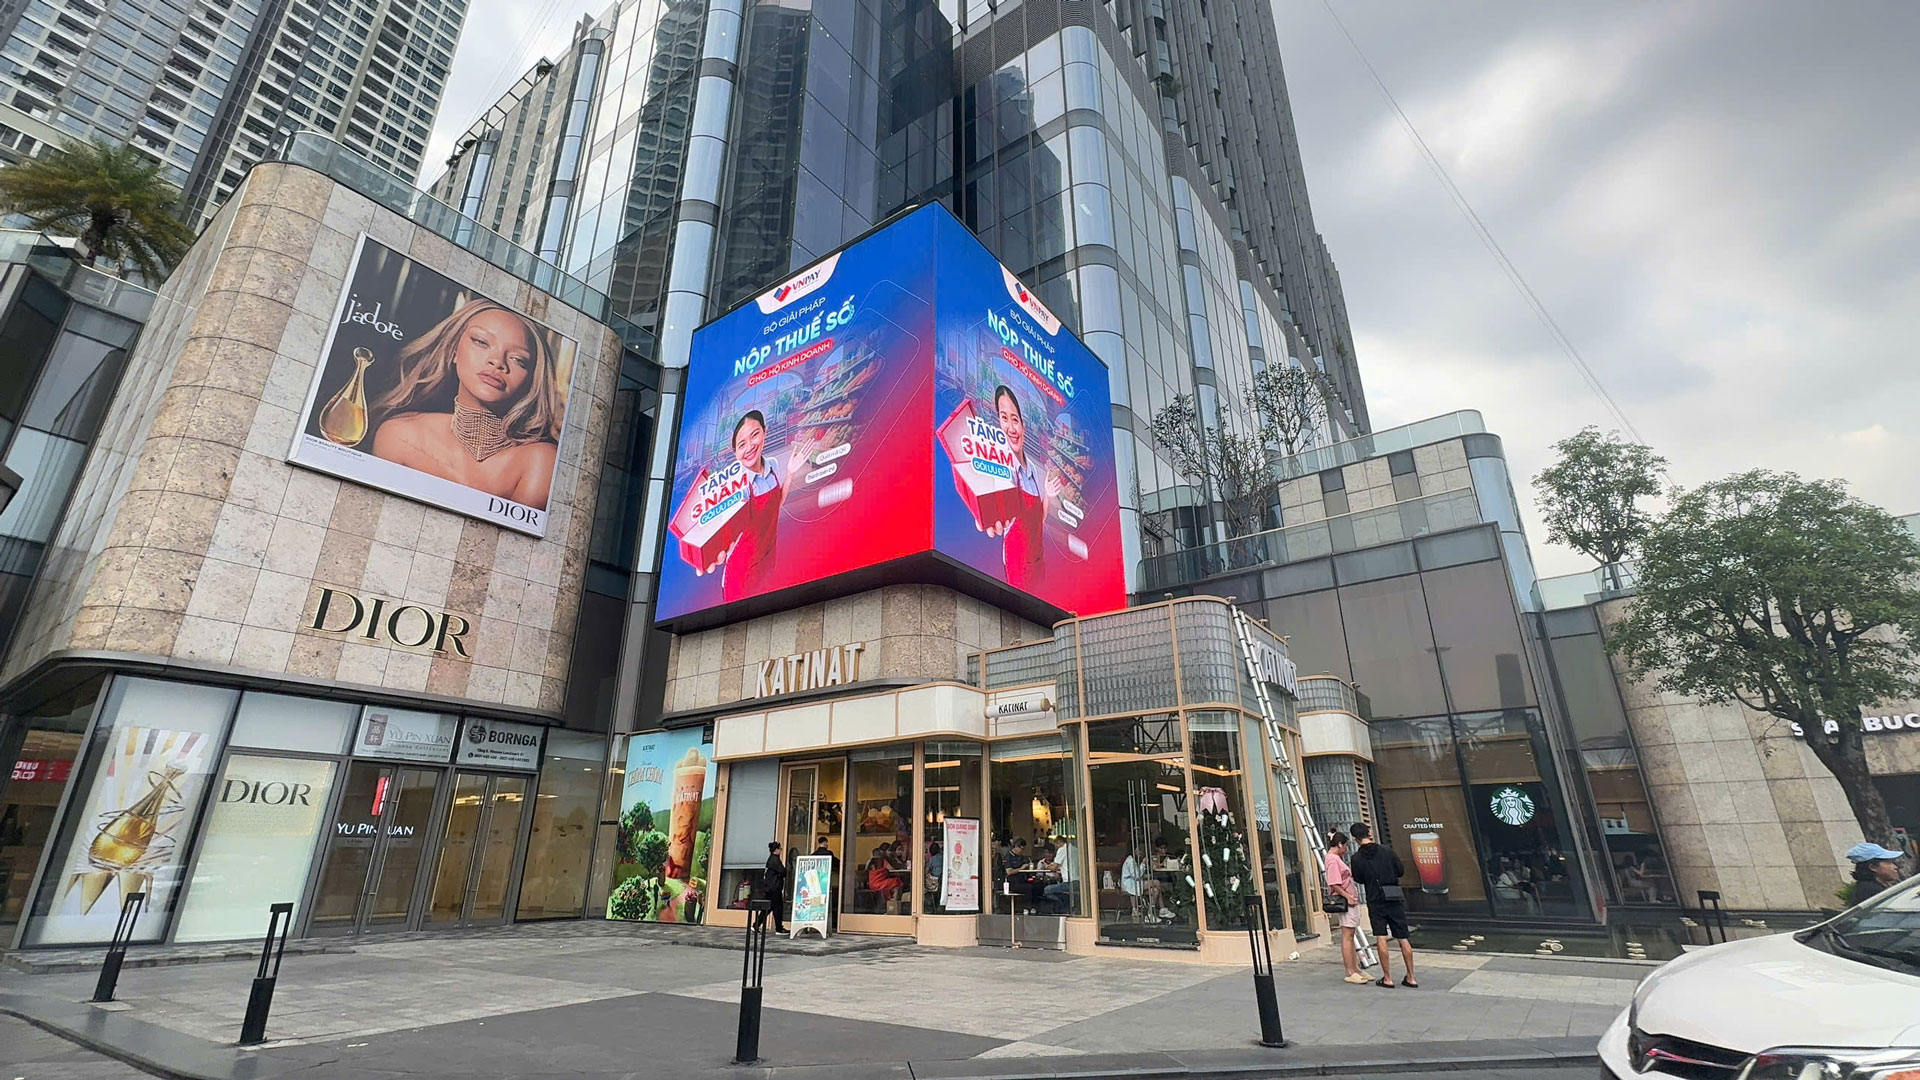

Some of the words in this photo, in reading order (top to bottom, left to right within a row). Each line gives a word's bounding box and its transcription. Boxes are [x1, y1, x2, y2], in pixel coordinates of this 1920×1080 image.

[792, 270, 821, 291] VNPAY
[341, 293, 403, 340] j'adore
[763, 321, 778, 335] BỘ
[778, 311, 798, 328] GIẢI
[799, 297, 826, 318] PHÁP
[734, 345, 771, 377] NỘP
[775, 310, 825, 356] THUẾ
[825, 295, 855, 332] SỐ
[749, 372, 767, 386] CHO
[768, 365, 781, 377] HỘ
[781, 357, 800, 370] KINH
[800, 342, 830, 361] DOANH
[988, 308, 1018, 347] NỘP
[1021, 339, 1055, 383] THUẾ
[1056, 371, 1075, 399] SỐ
[1003, 350, 1018, 367] CHO
[967, 419, 1006, 445] TẶNG
[962, 437, 974, 455] 3
[975, 441, 1014, 468] NĂM
[700, 462, 741, 496] TẶNG
[692, 503, 703, 519] 3
[705, 473, 748, 511] NĂM
[488, 497, 538, 527] DIOR
[304, 586, 472, 659] DIOR
[755, 642, 865, 699] KATINAT
[998, 701, 1028, 714] KATINAT
[389, 729, 403, 741] YU
[405, 730, 421, 742] PIN
[425, 733, 453, 746] XUAN
[488, 730, 537, 747] BORNGA
[1791, 713, 1920, 737] SABUC
[219, 780, 312, 806] DIOR
[337, 823, 355, 835] YU
[386, 826, 414, 836] UAN
